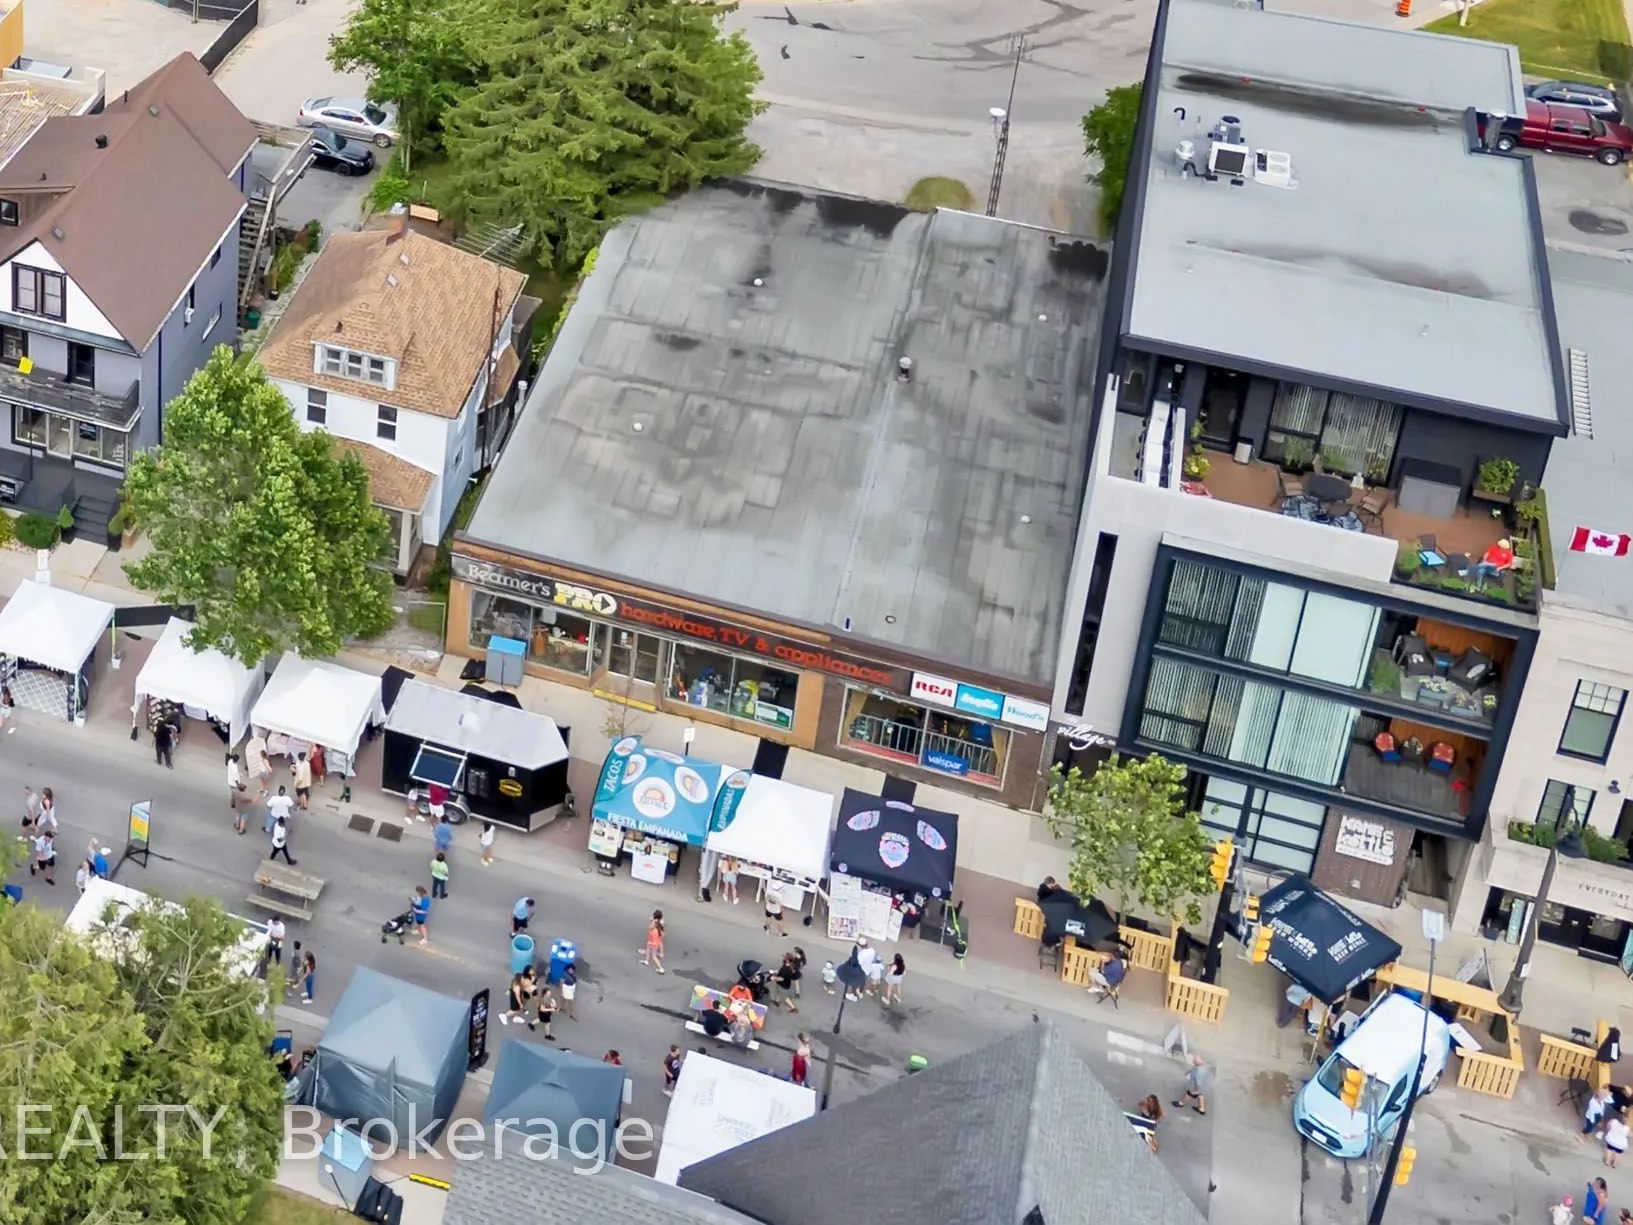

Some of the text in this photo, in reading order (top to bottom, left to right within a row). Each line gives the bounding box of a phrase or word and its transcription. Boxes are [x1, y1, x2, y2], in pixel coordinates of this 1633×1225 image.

[468, 563, 551, 598] Beamer's
[553, 582, 618, 615] PRO
[719, 626, 752, 646] TV
[755, 638, 769, 652] &
[774, 644, 894, 685] appliances
[914, 680, 954, 698] RCA
[1056, 723, 1106, 751] village
[602, 759, 624, 793] TACOS
[927, 754, 963, 770] valspar
[607, 812, 689, 842] FIESTA EMPANADA
[1578, 883, 1631, 901] EVERYDAY
